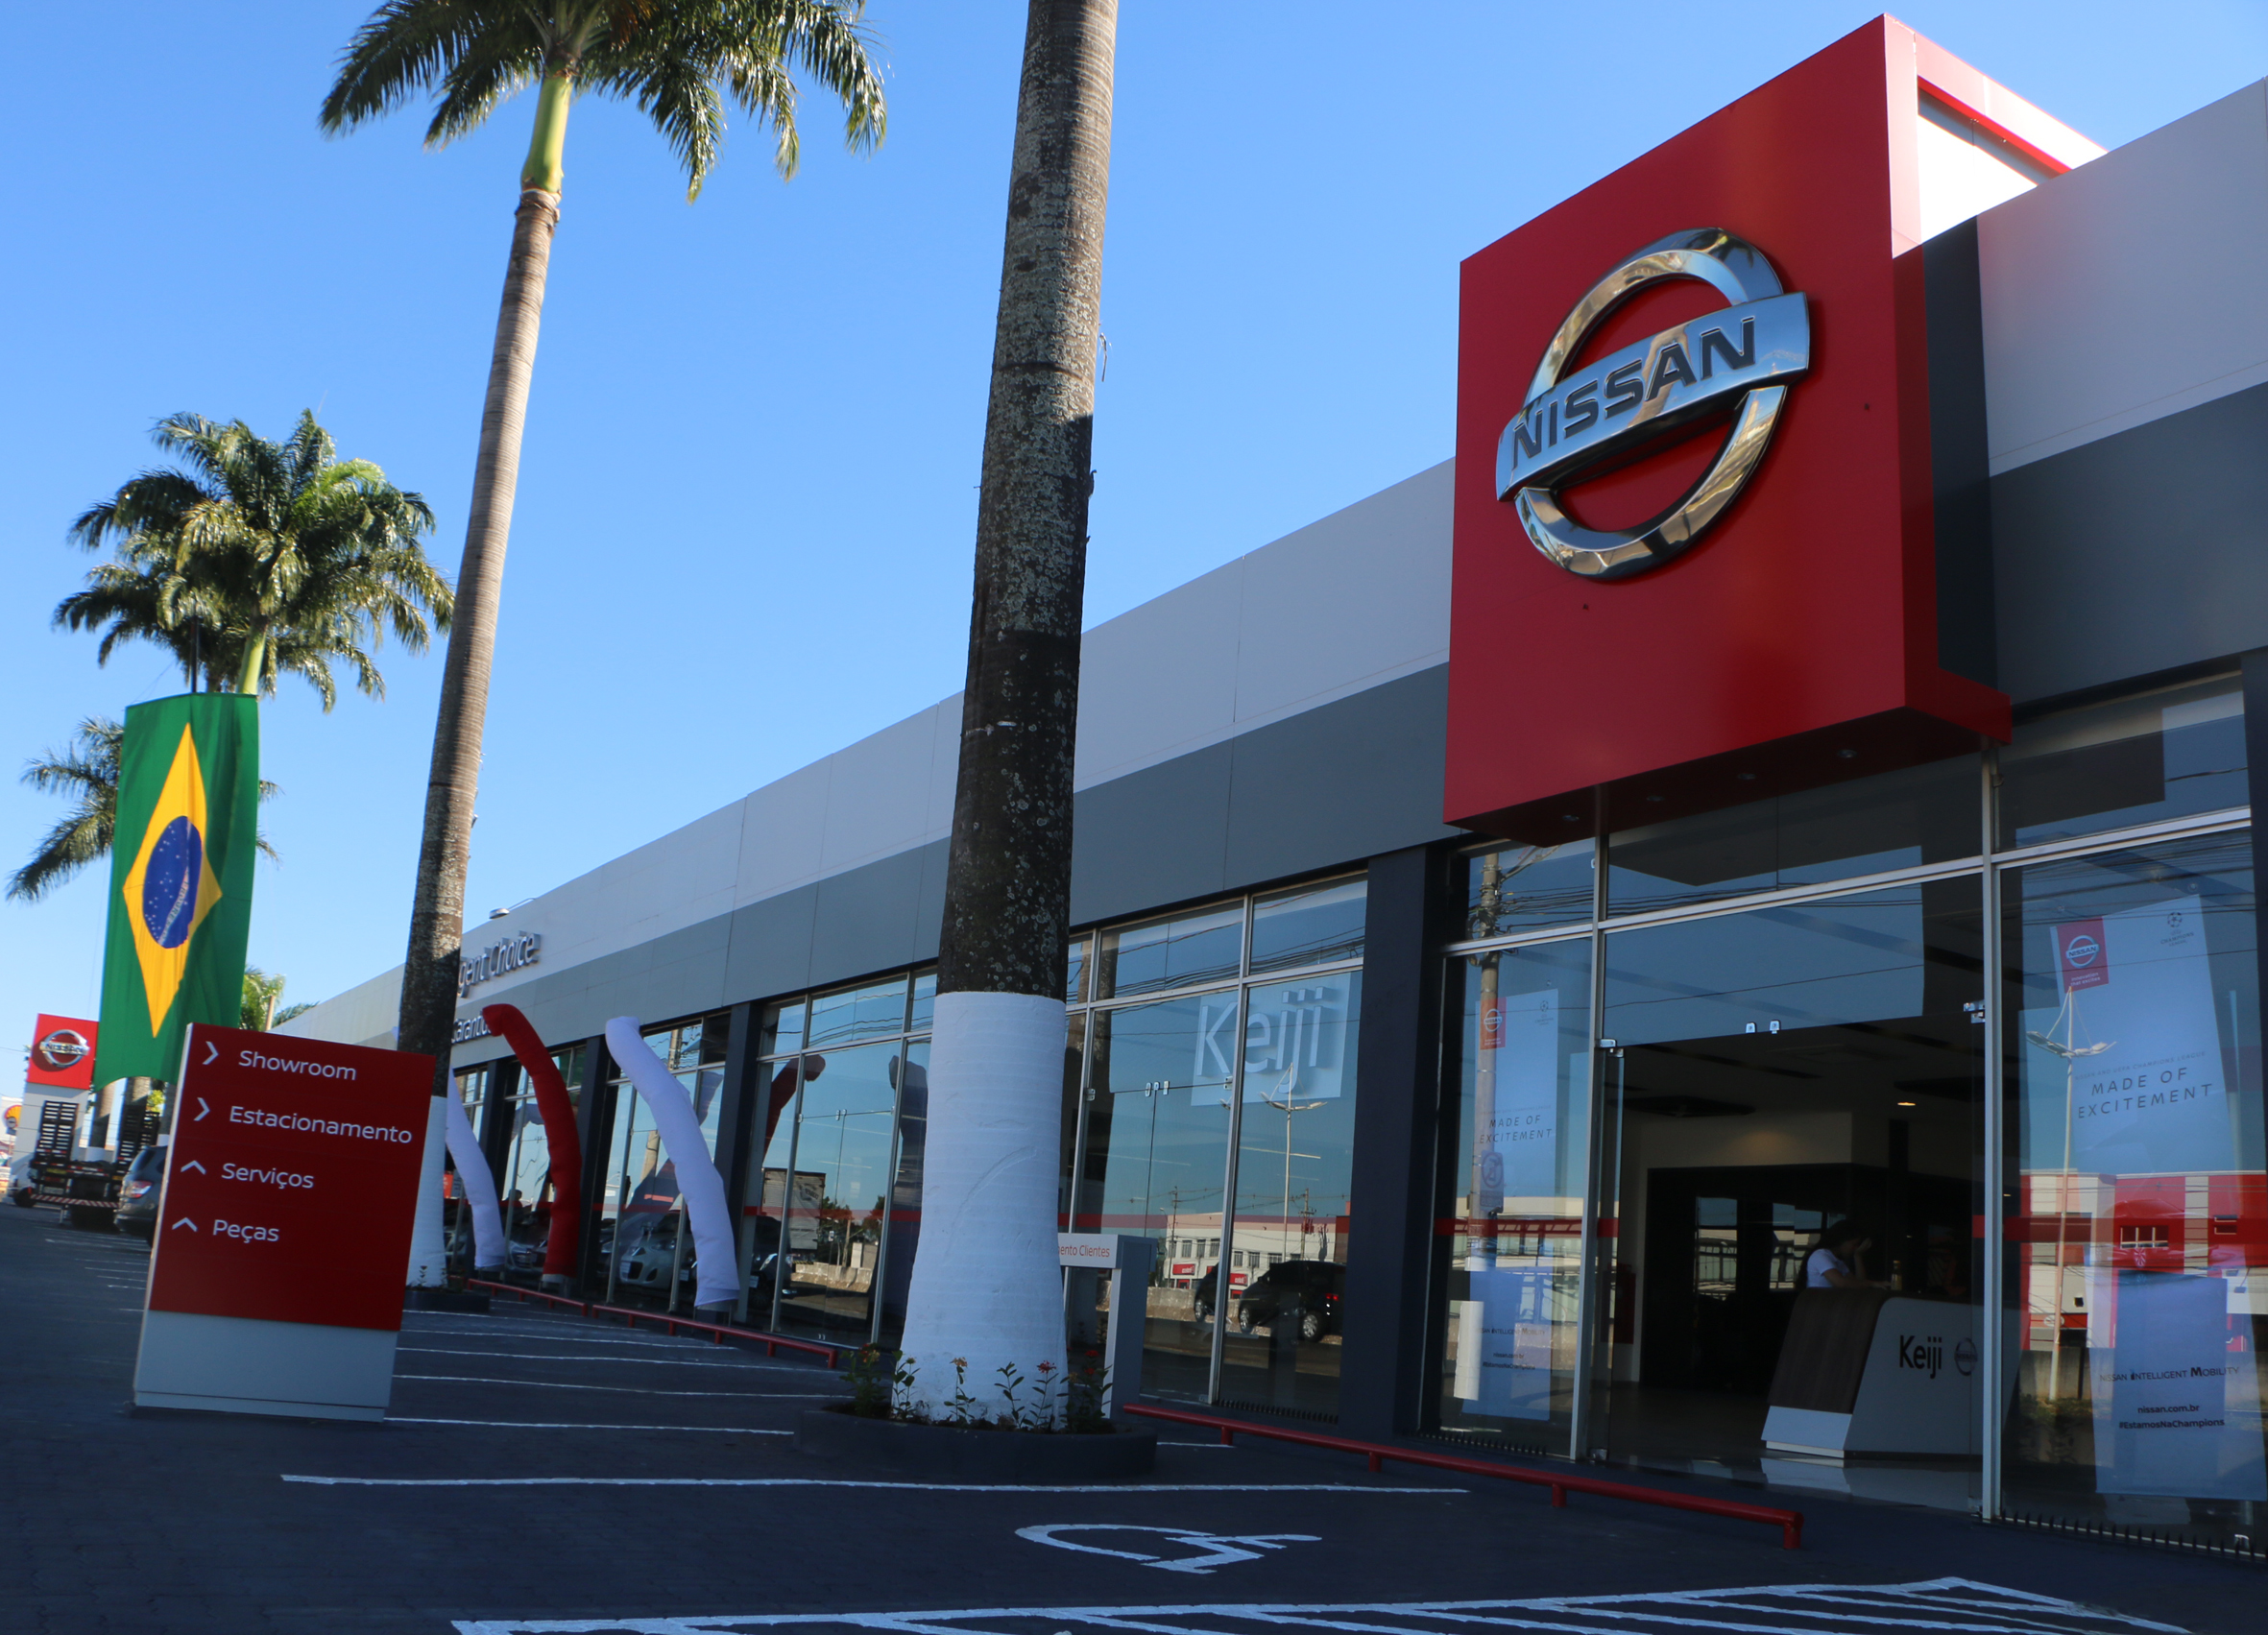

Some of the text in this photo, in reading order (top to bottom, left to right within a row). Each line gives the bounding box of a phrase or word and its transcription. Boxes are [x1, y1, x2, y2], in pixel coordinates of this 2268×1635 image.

[1512, 316, 1755, 470] NISSAN
[489, 932, 541, 976] Choice
[2068, 946, 2097, 957] NISSAN
[1196, 986, 1324, 1094] Keiji
[239, 1050, 357, 1081] Showroom
[2133, 1058, 2175, 1070] CHAMPIONS
[2177, 1051, 2206, 1062] LEAGUE
[2091, 1067, 2188, 1096] MADE OF
[2078, 1083, 2213, 1119] EXCITEMENT
[229, 1105, 413, 1144] Estacionamento
[1489, 1114, 1541, 1128] MADE OF
[1480, 1128, 1553, 1143] EXCITEMENT
[221, 1163, 315, 1190] Serviços
[212, 1219, 280, 1244] Peças
[1079, 1244, 1111, 1258] Clientes
[1899, 1334, 1942, 1380] Keiji
[2099, 1373, 2128, 1383] NISSAN
[2190, 1366, 2240, 1378] MOBILITY
[2137, 1404, 2201, 1414] nissan.com.br
[2118, 1418, 2226, 1430] #EstamosNaChampions
